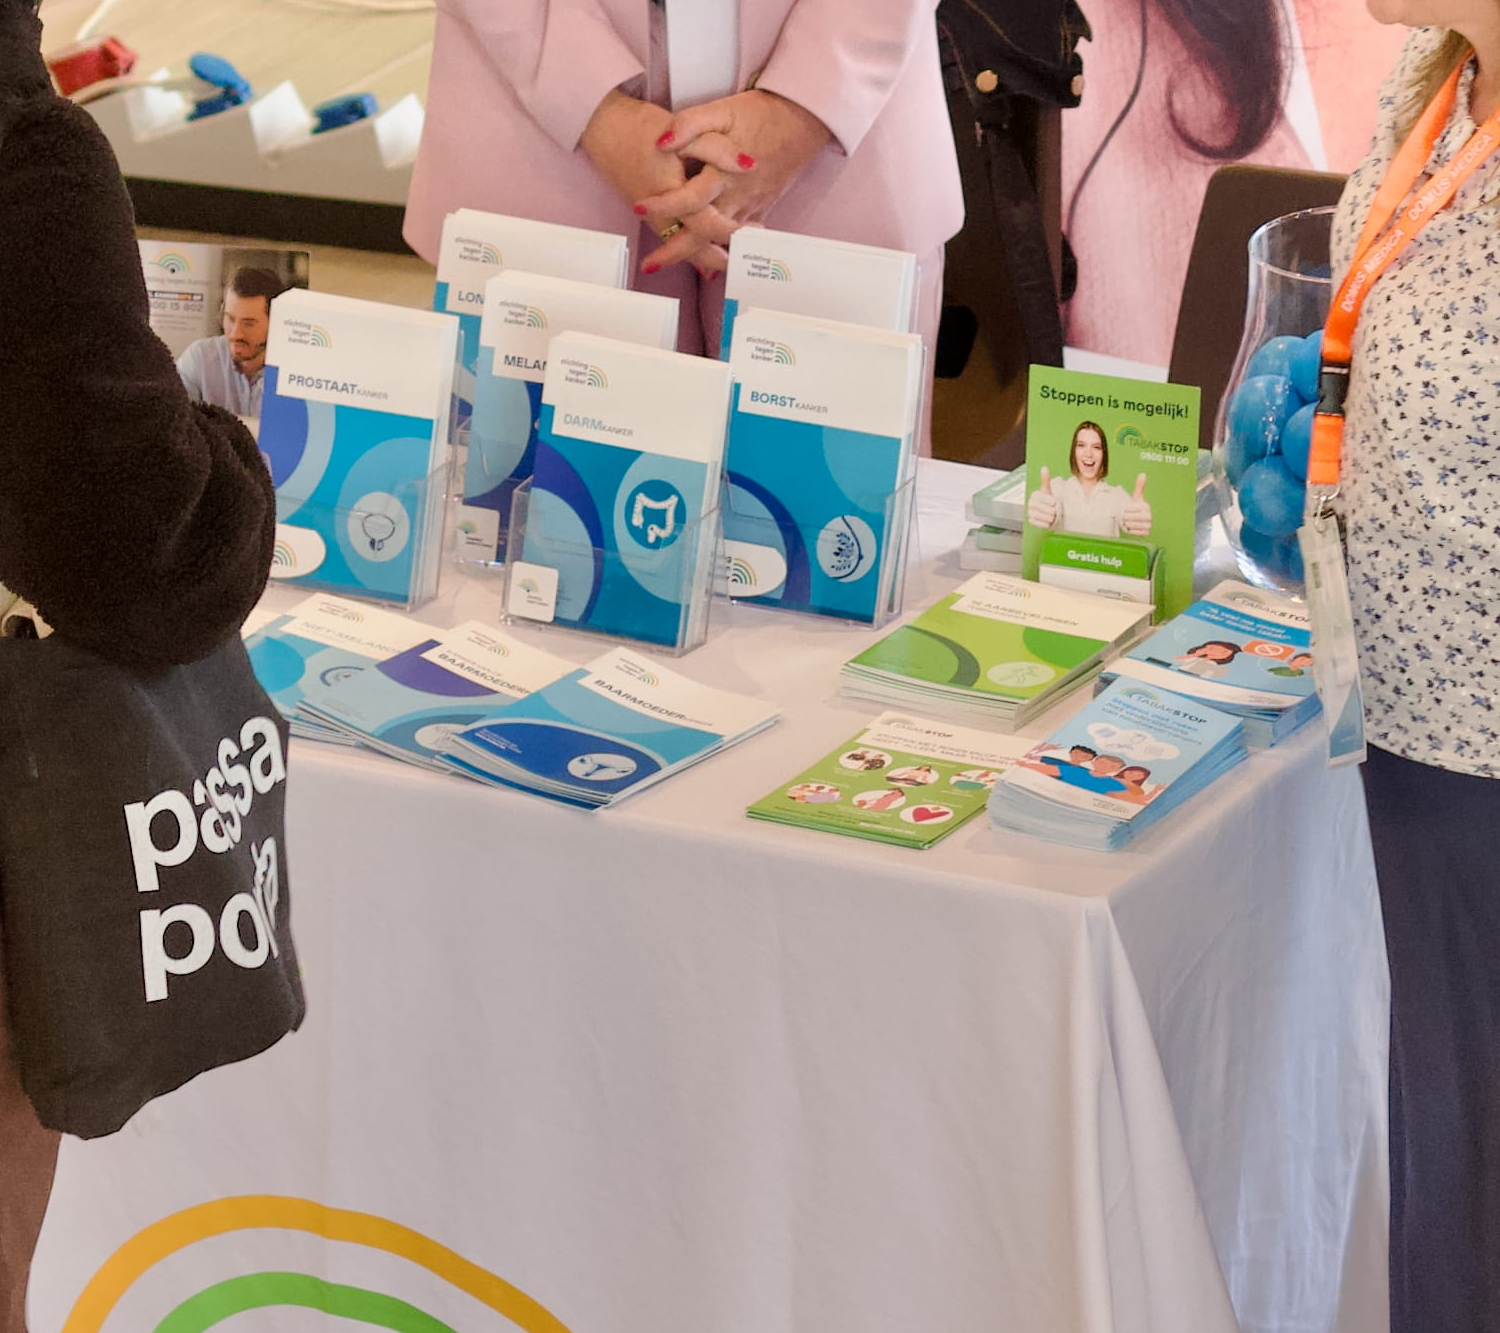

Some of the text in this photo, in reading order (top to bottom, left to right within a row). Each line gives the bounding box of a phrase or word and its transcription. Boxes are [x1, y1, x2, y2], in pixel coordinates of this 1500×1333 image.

[1407, 133, 1494, 221] DOMUS MEDICA
[1363, 227, 1405, 274] MEDICA
[1039, 385, 1189, 420] Stoppen is mogelijk!
[1066, 549, 1123, 569] Gratis hulp
[122, 714, 287, 893] passa
